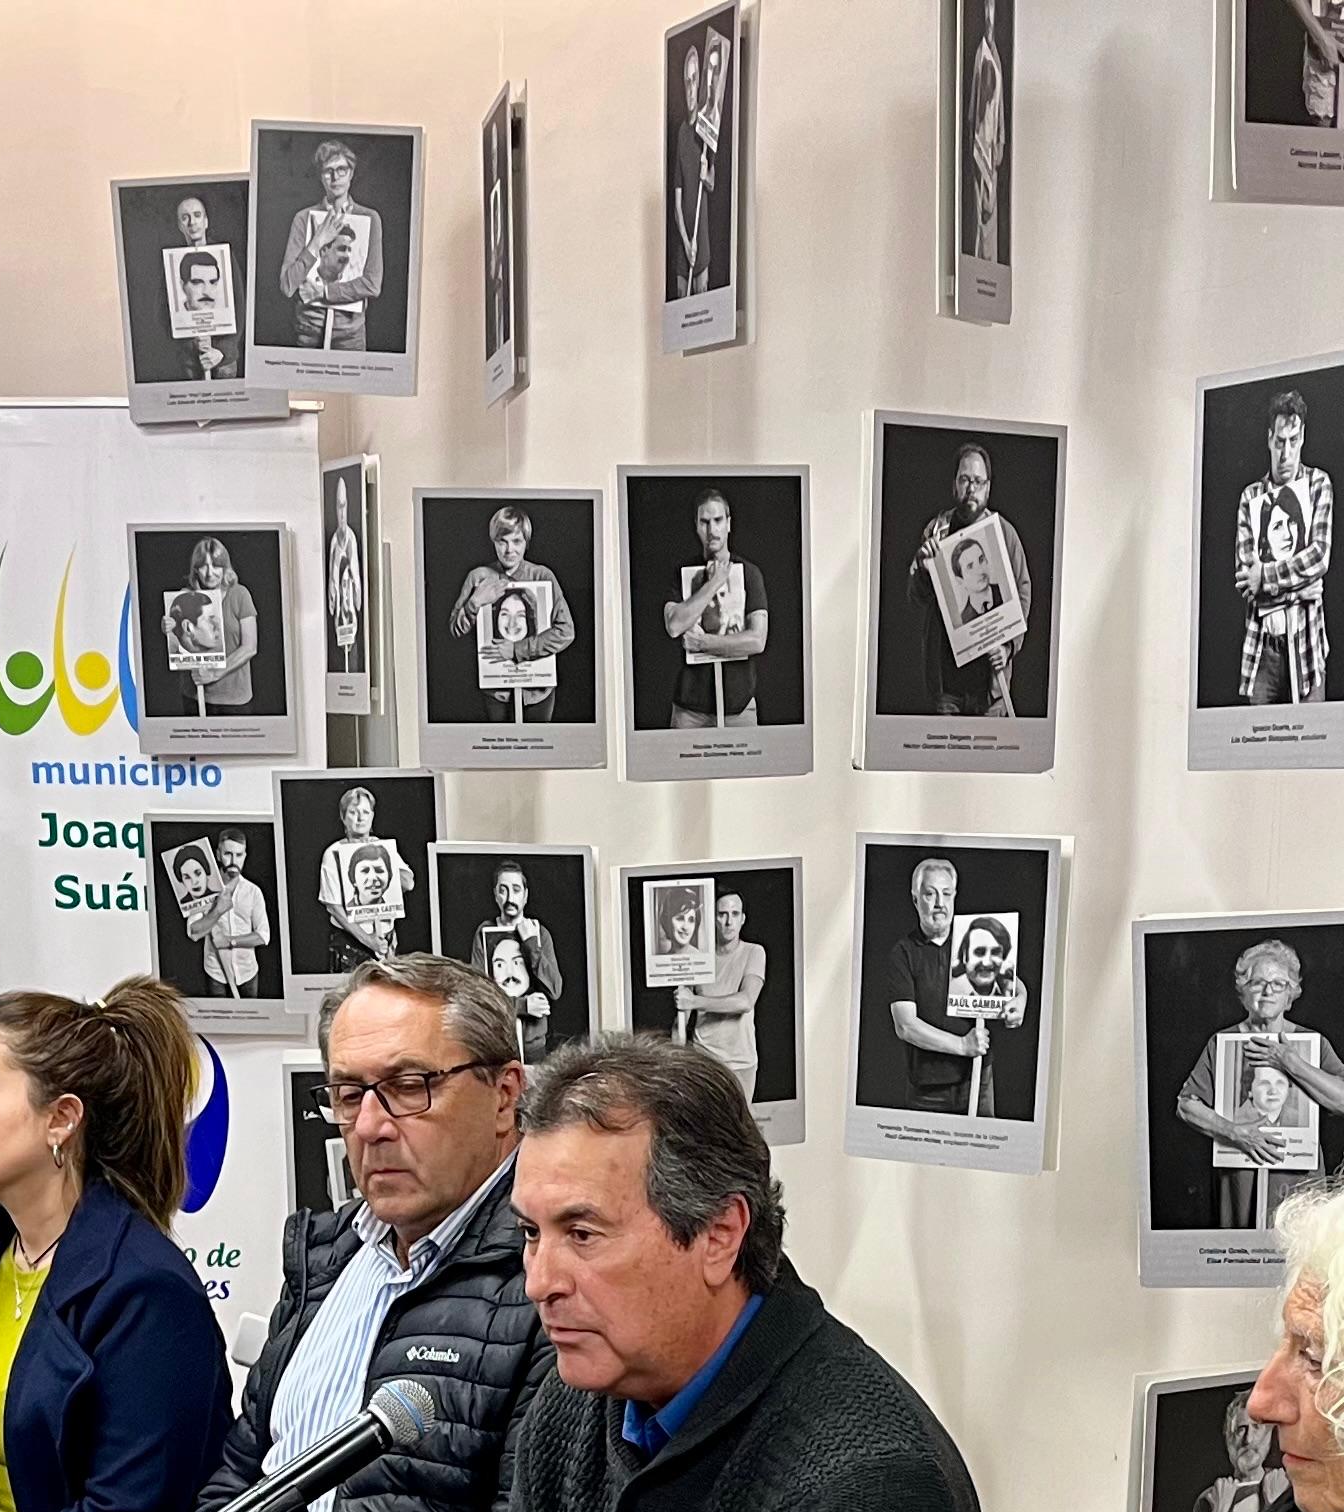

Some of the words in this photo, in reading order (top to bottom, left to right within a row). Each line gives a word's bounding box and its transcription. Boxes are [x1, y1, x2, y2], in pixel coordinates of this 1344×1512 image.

[31, 755, 223, 794] municipio
[38, 812, 145, 858] Joaq
[54, 871, 148, 911] Suá
[948, 996, 970, 1008] RAÚL
[206, 1242, 241, 1268] de
